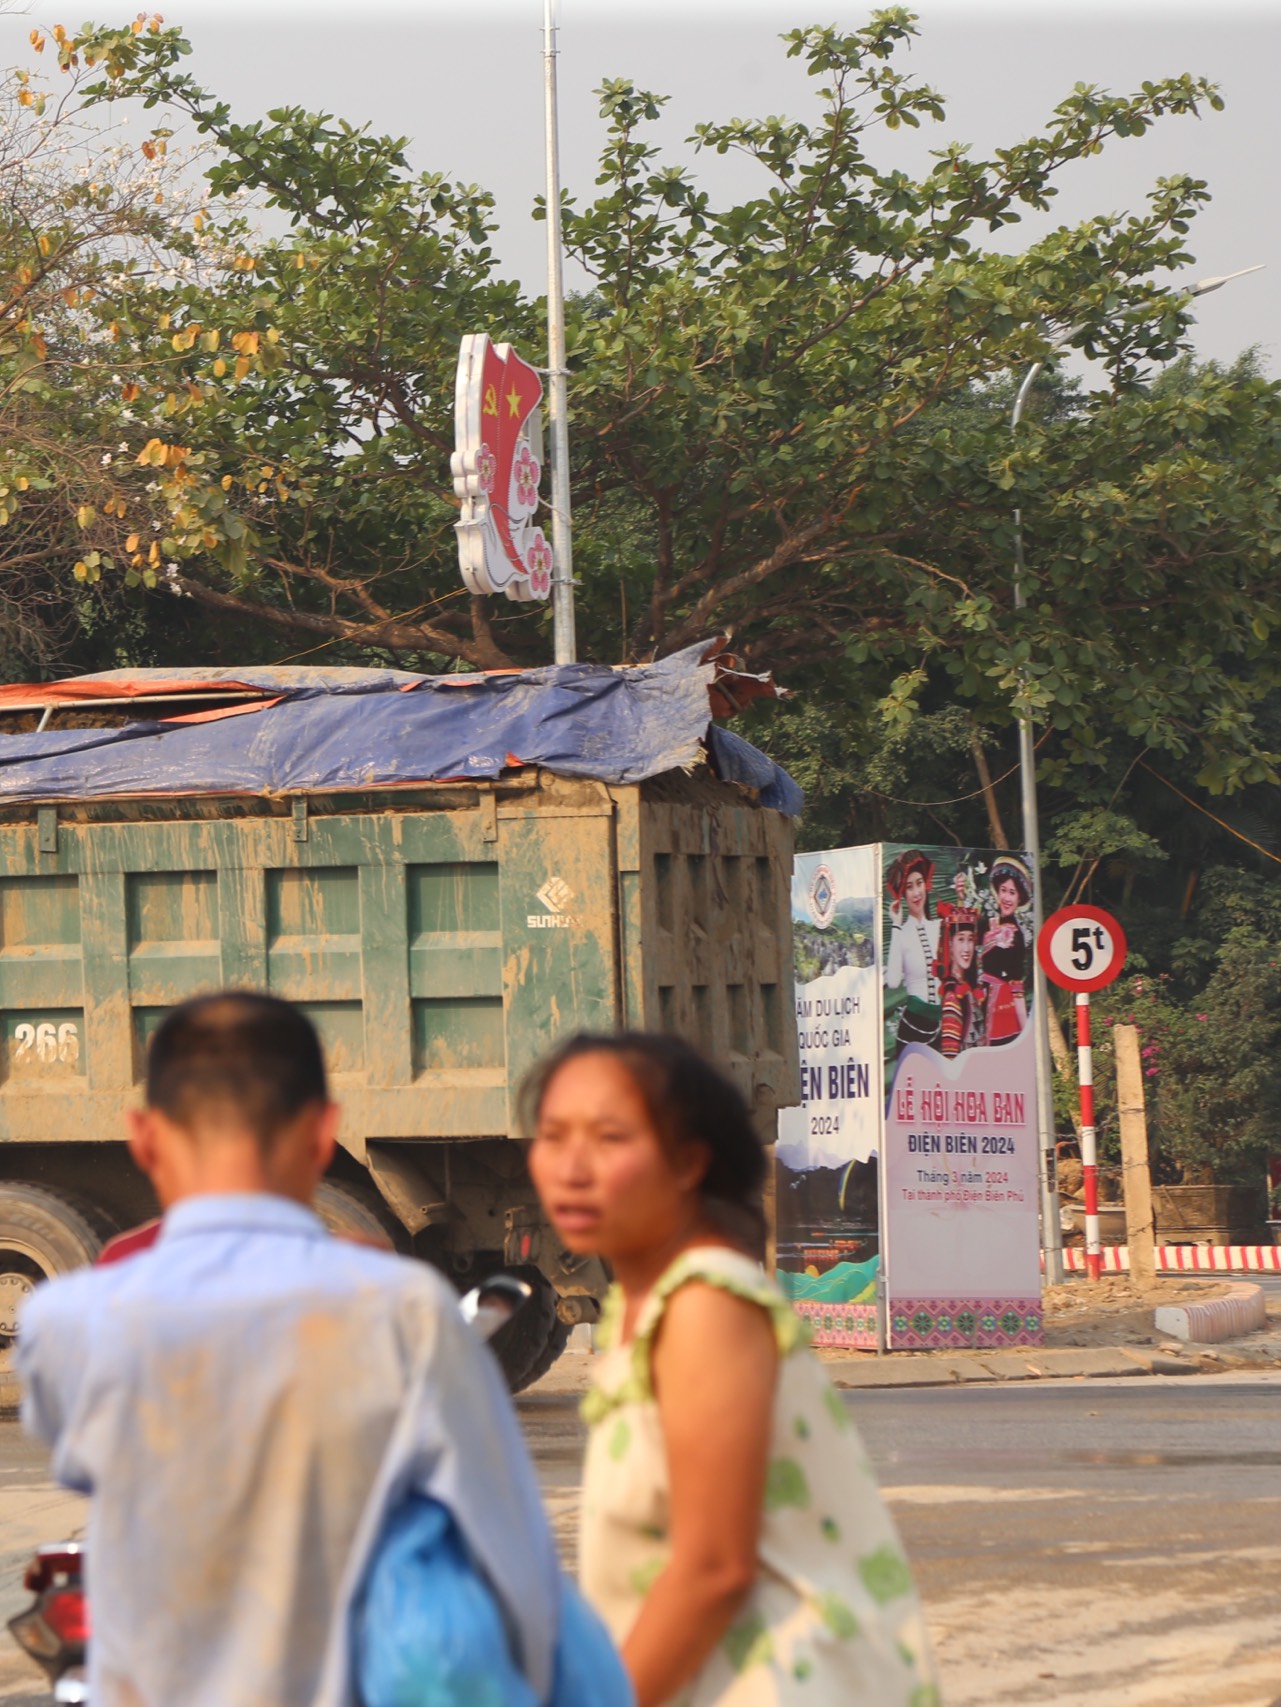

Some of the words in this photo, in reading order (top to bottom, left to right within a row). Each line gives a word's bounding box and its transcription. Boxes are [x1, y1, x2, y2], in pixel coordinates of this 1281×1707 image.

[796, 997, 812, 1017] ĂM
[816, 1000, 831, 1017] DU
[834, 997, 860, 1019] LỊCH
[14, 1023, 80, 1064] 266
[798, 1024, 829, 1049] QUỐC
[832, 1029, 851, 1047] GIA
[800, 1059, 822, 1109] ỆN
[828, 1057, 869, 1100] BIÊN
[921, 1083, 949, 1131] HỘI
[953, 1090, 988, 1123] HOA
[993, 1092, 1025, 1124] BAN
[811, 1116, 840, 1135] 2024
[908, 1131, 941, 1157] ĐIỆN
[945, 1132, 978, 1154] BIÊN
[981, 1136, 1016, 1155] 2024
[916, 1167, 949, 1185] Tháng
[951, 1171, 959, 1183] 3
[985, 1171, 1008, 1184] 2024
